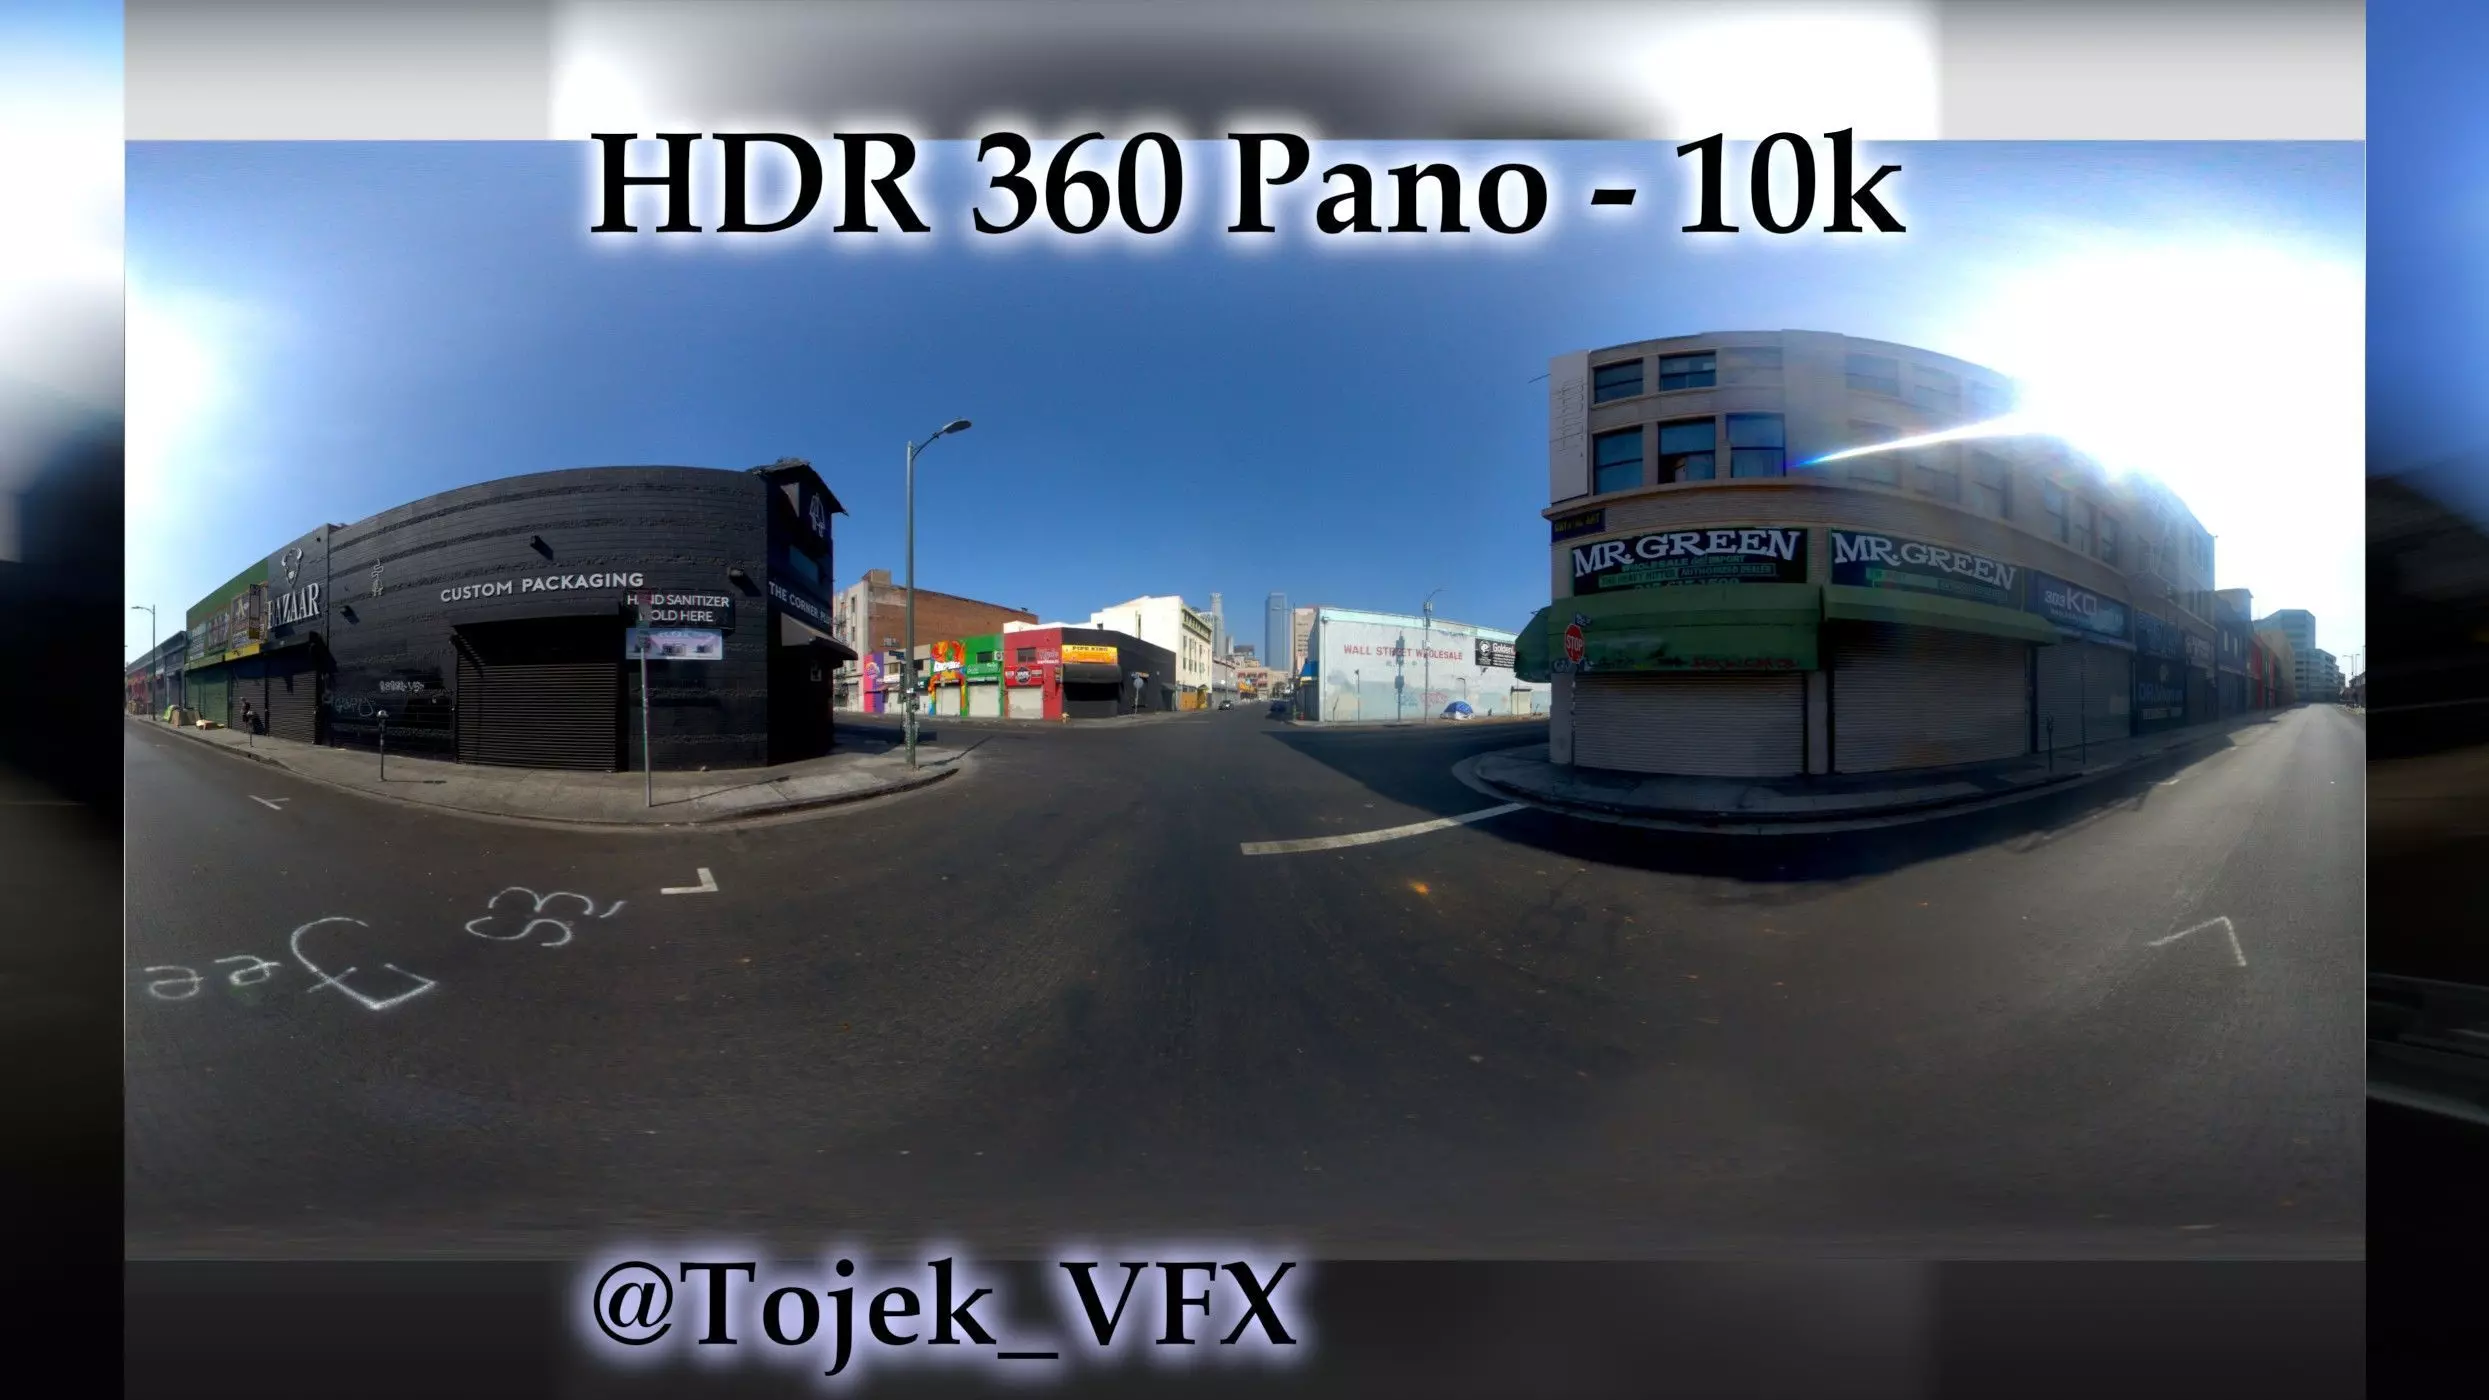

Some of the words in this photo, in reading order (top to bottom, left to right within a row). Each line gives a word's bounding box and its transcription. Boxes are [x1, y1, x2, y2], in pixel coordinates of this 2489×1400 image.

[1635, 530, 1802, 560] GREEN
[1900, 543, 2017, 591] GREEN
[440, 580, 513, 602] CUSTOM
[522, 572, 644, 593] PACKAGING
[666, 594, 730, 608] SANITIZER
[768, 581, 788, 602] THE
[789, 593, 819, 618] CORNER
[267, 583, 320, 630] BAZAAR
[639, 610, 678, 621] OLD
[680, 610, 714, 622] HERE
[1343, 644, 1372, 656] WALL
[1566, 635, 1584, 651] STOP
